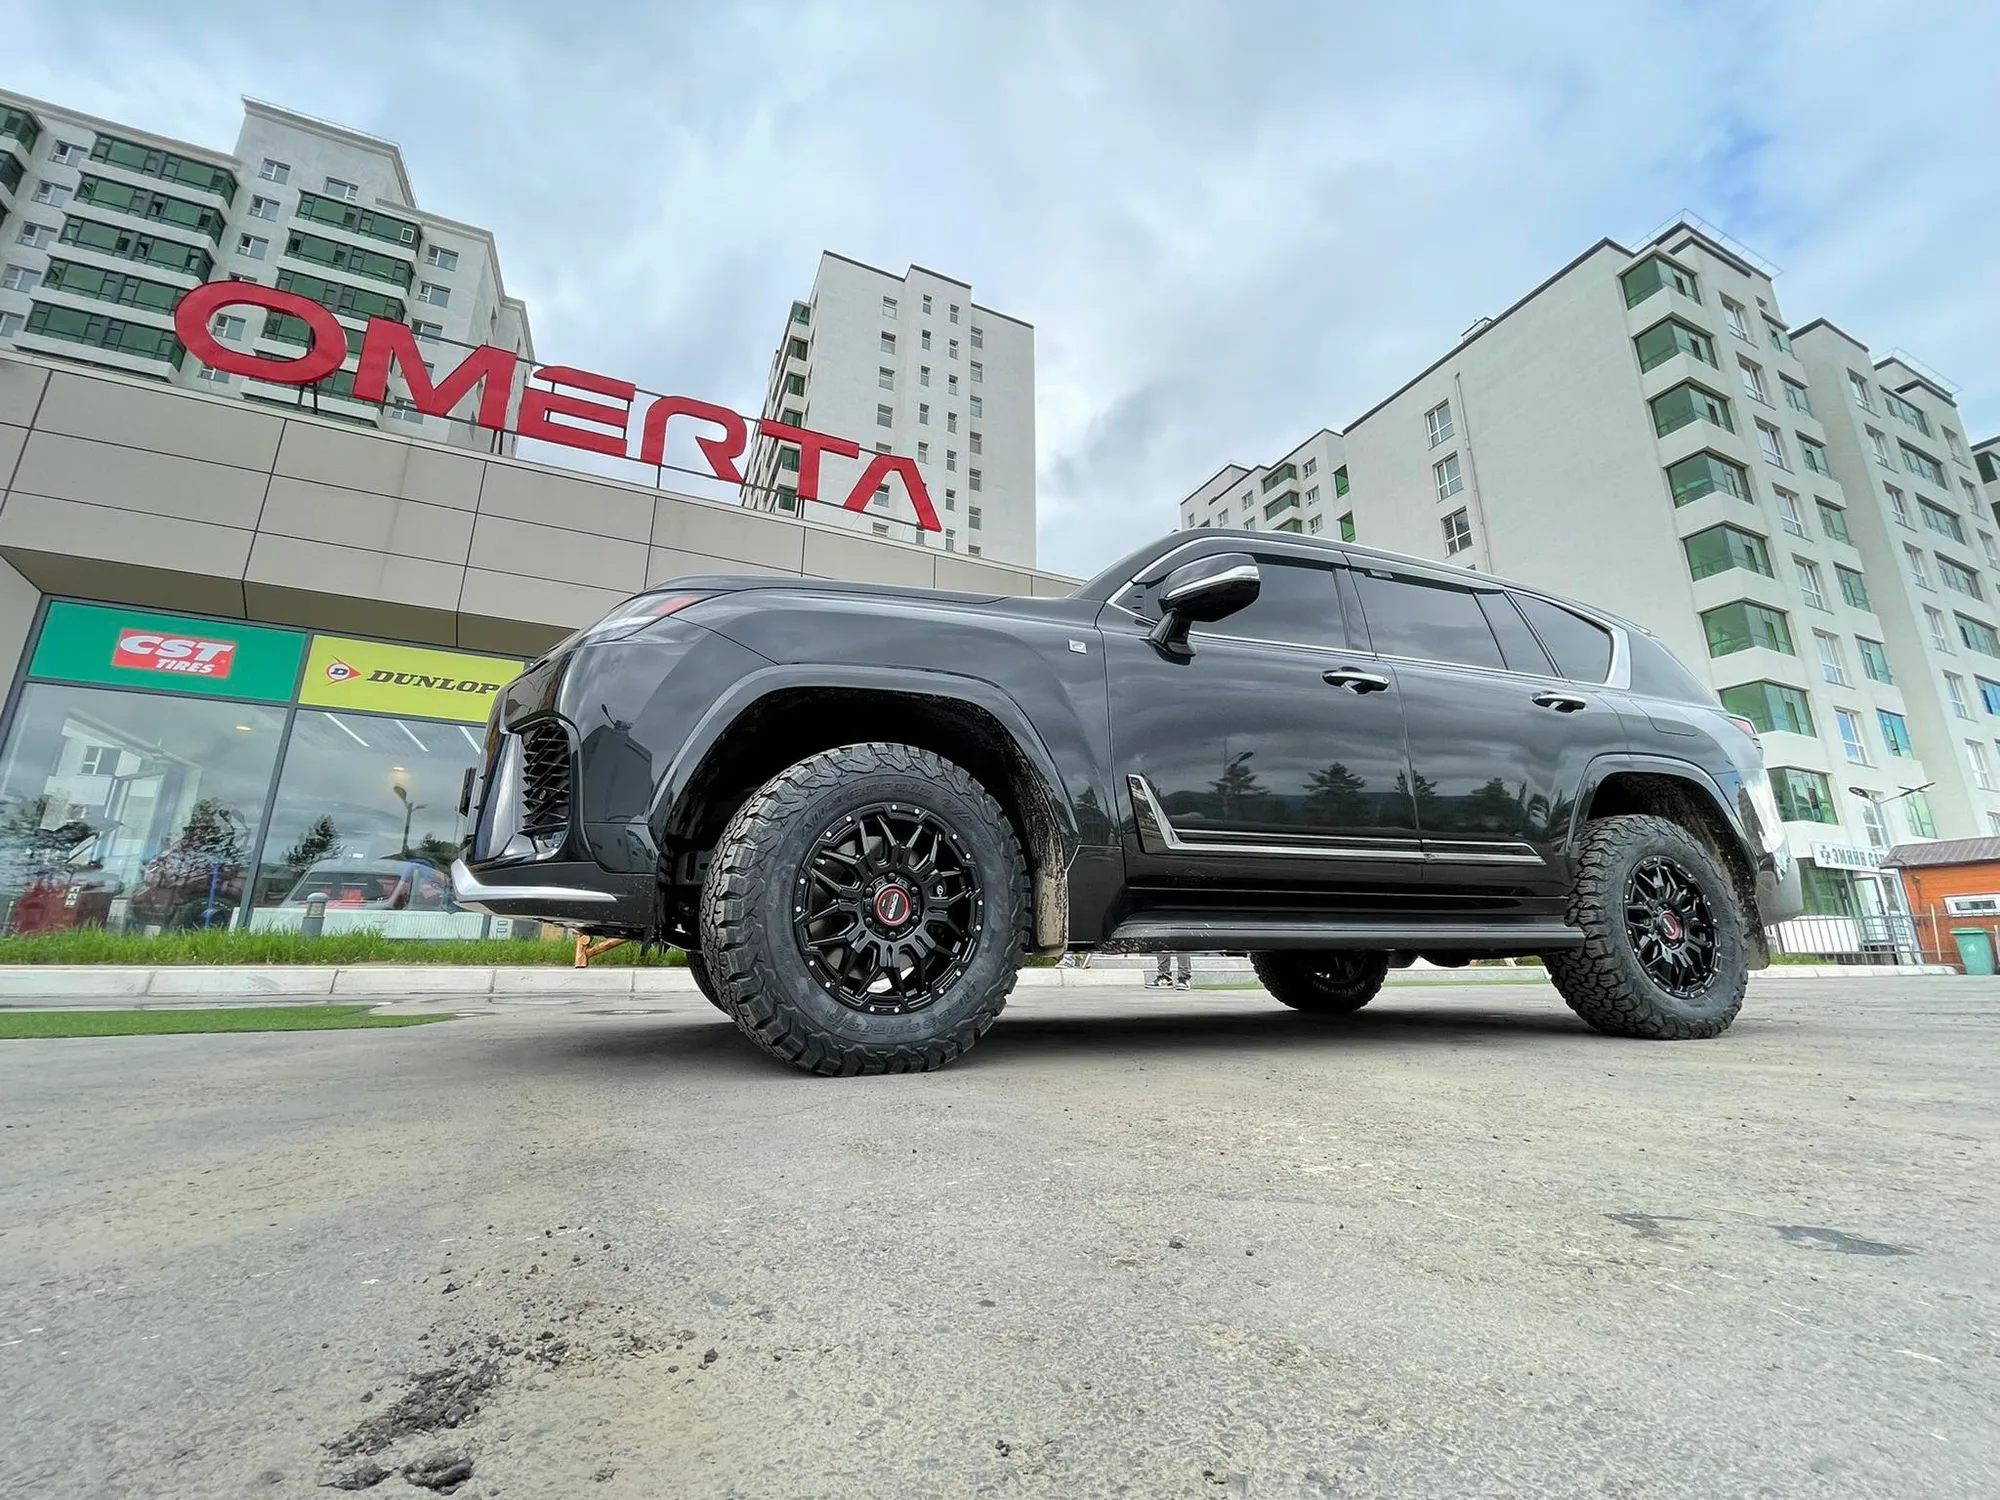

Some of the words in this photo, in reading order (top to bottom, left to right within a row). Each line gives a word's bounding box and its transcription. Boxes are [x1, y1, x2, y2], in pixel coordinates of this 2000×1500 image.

[174, 280, 941, 532] OMERTA
[120, 635, 235, 662] CST
[155, 659, 216, 674] TIRES
[367, 669, 501, 695] DUNLOP
